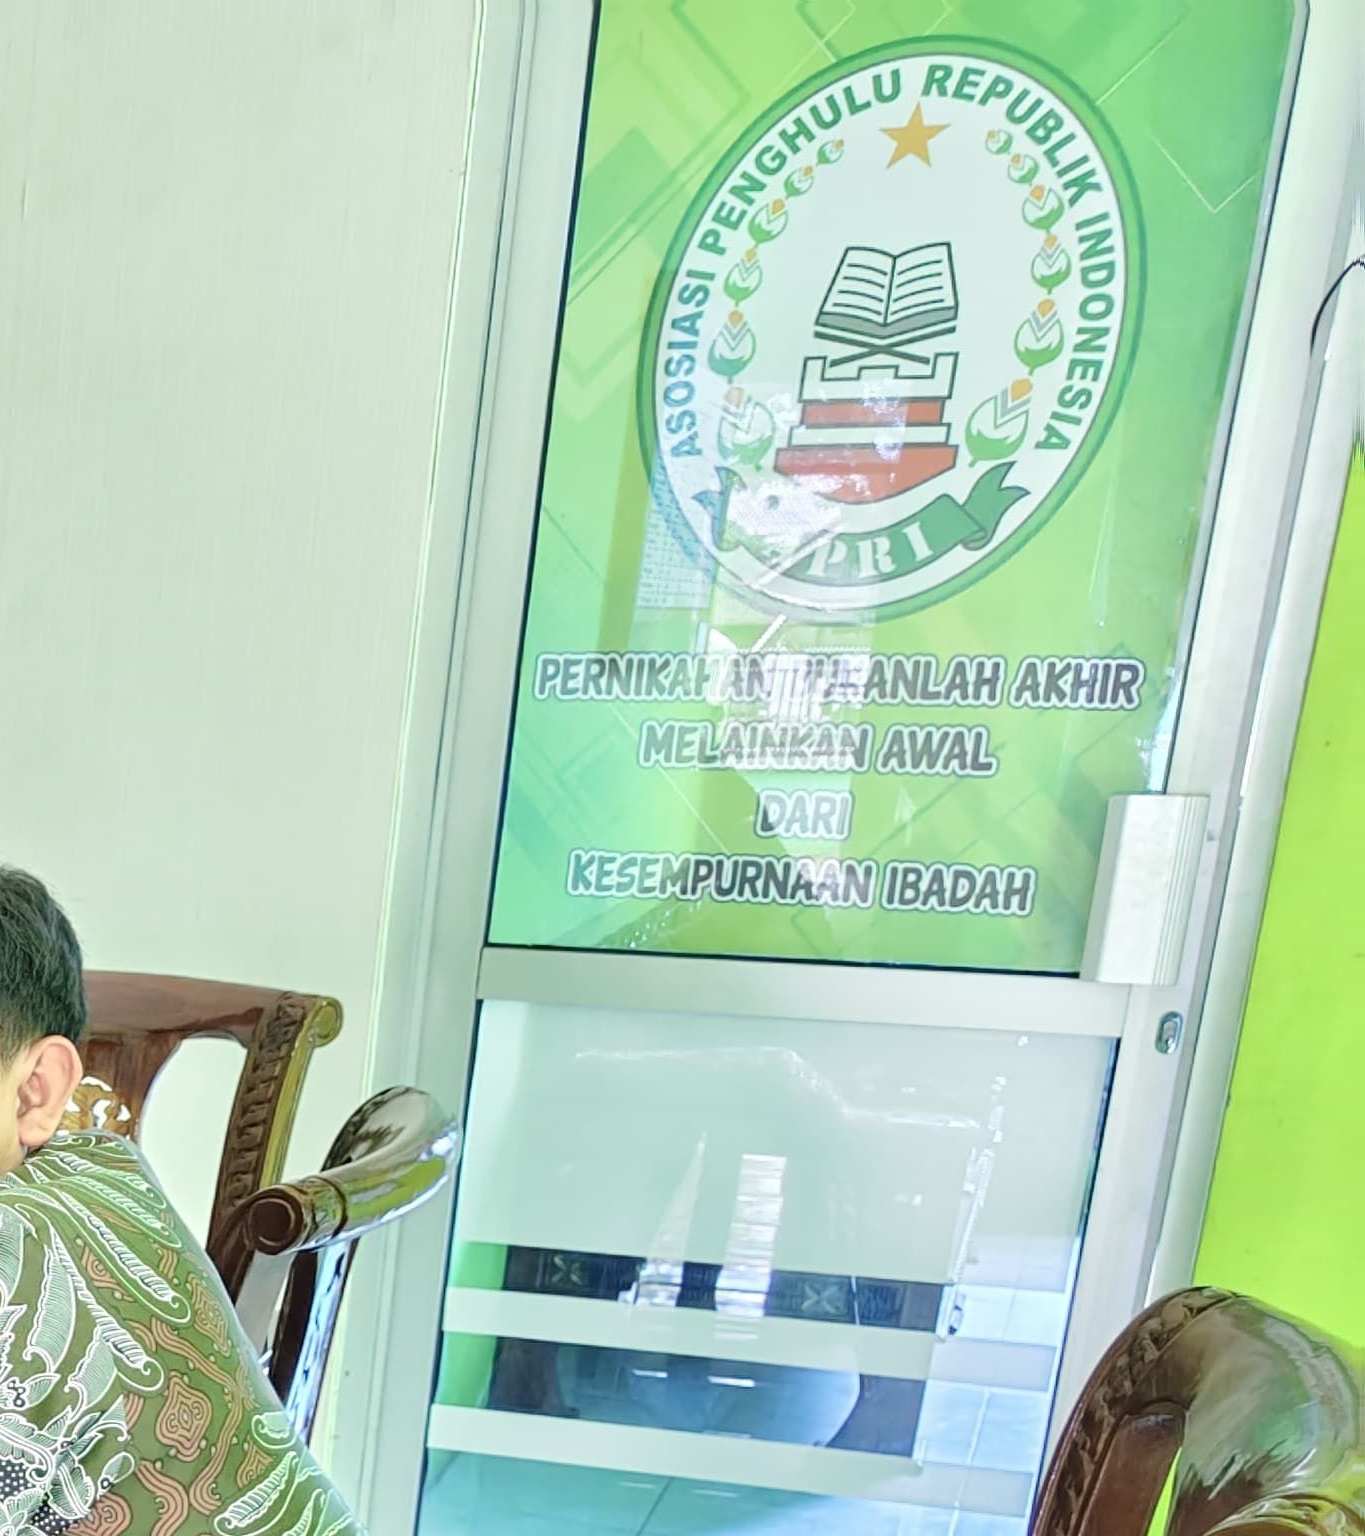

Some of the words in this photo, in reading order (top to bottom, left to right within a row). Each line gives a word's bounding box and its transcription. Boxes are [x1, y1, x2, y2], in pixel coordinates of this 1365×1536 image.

[663, 269, 716, 458] ASOSIASI
[697, 68, 901, 256] PENGHULU
[921, 63, 1103, 208] REPUBLIK
[1035, 212, 1115, 451] INDONESIA
[771, 520, 935, 580] PRI
[1011, 658, 1142, 707] AKHIR
[640, 722, 870, 770] MELAINKAN
[879, 727, 997, 773] AWAL
[758, 791, 852, 838] DARI
[569, 852, 875, 905] KESEMPURNAAN
[885, 862, 1035, 913] IBADAH
